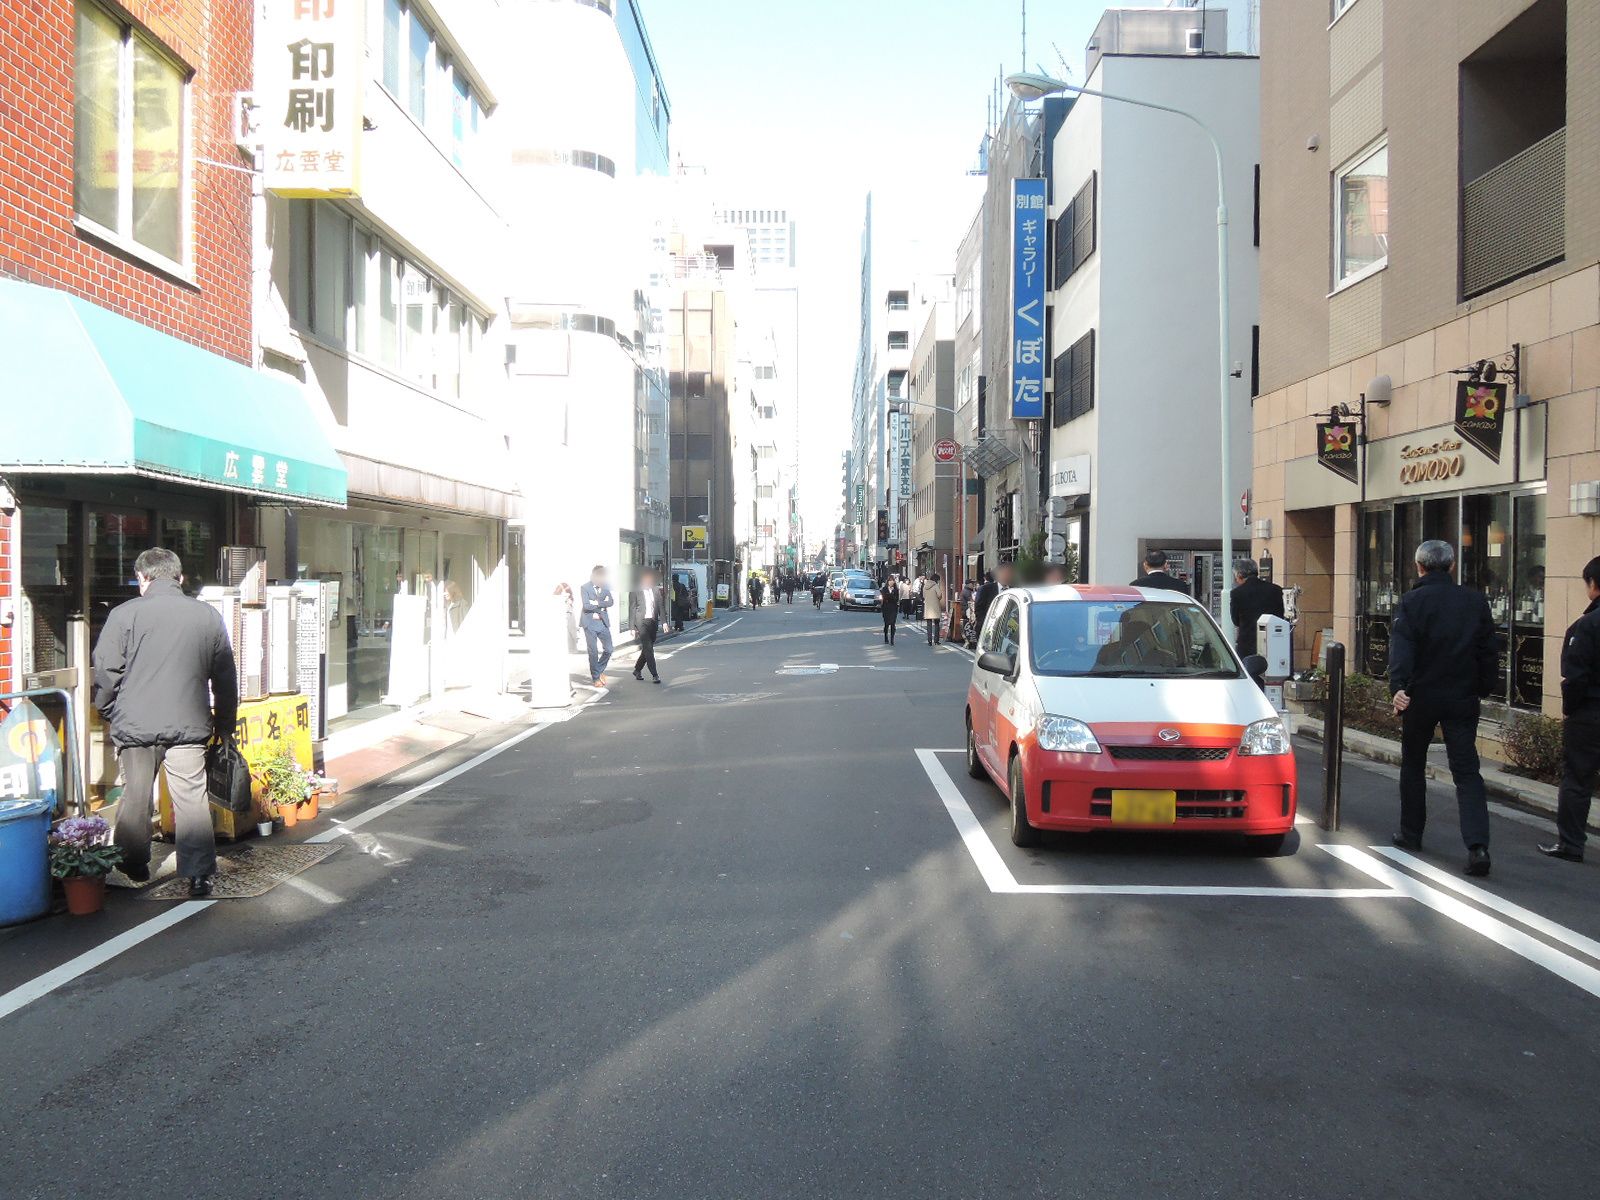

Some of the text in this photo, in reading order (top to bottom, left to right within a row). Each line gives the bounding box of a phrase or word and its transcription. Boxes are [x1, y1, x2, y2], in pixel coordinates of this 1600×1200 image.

[284, 38, 334, 133] 印刷
[1016, 194, 1044, 209] 別館
[1015, 219, 1043, 403] ギャラリー くぼた
[1400, 455, 1464, 484] COMODO
